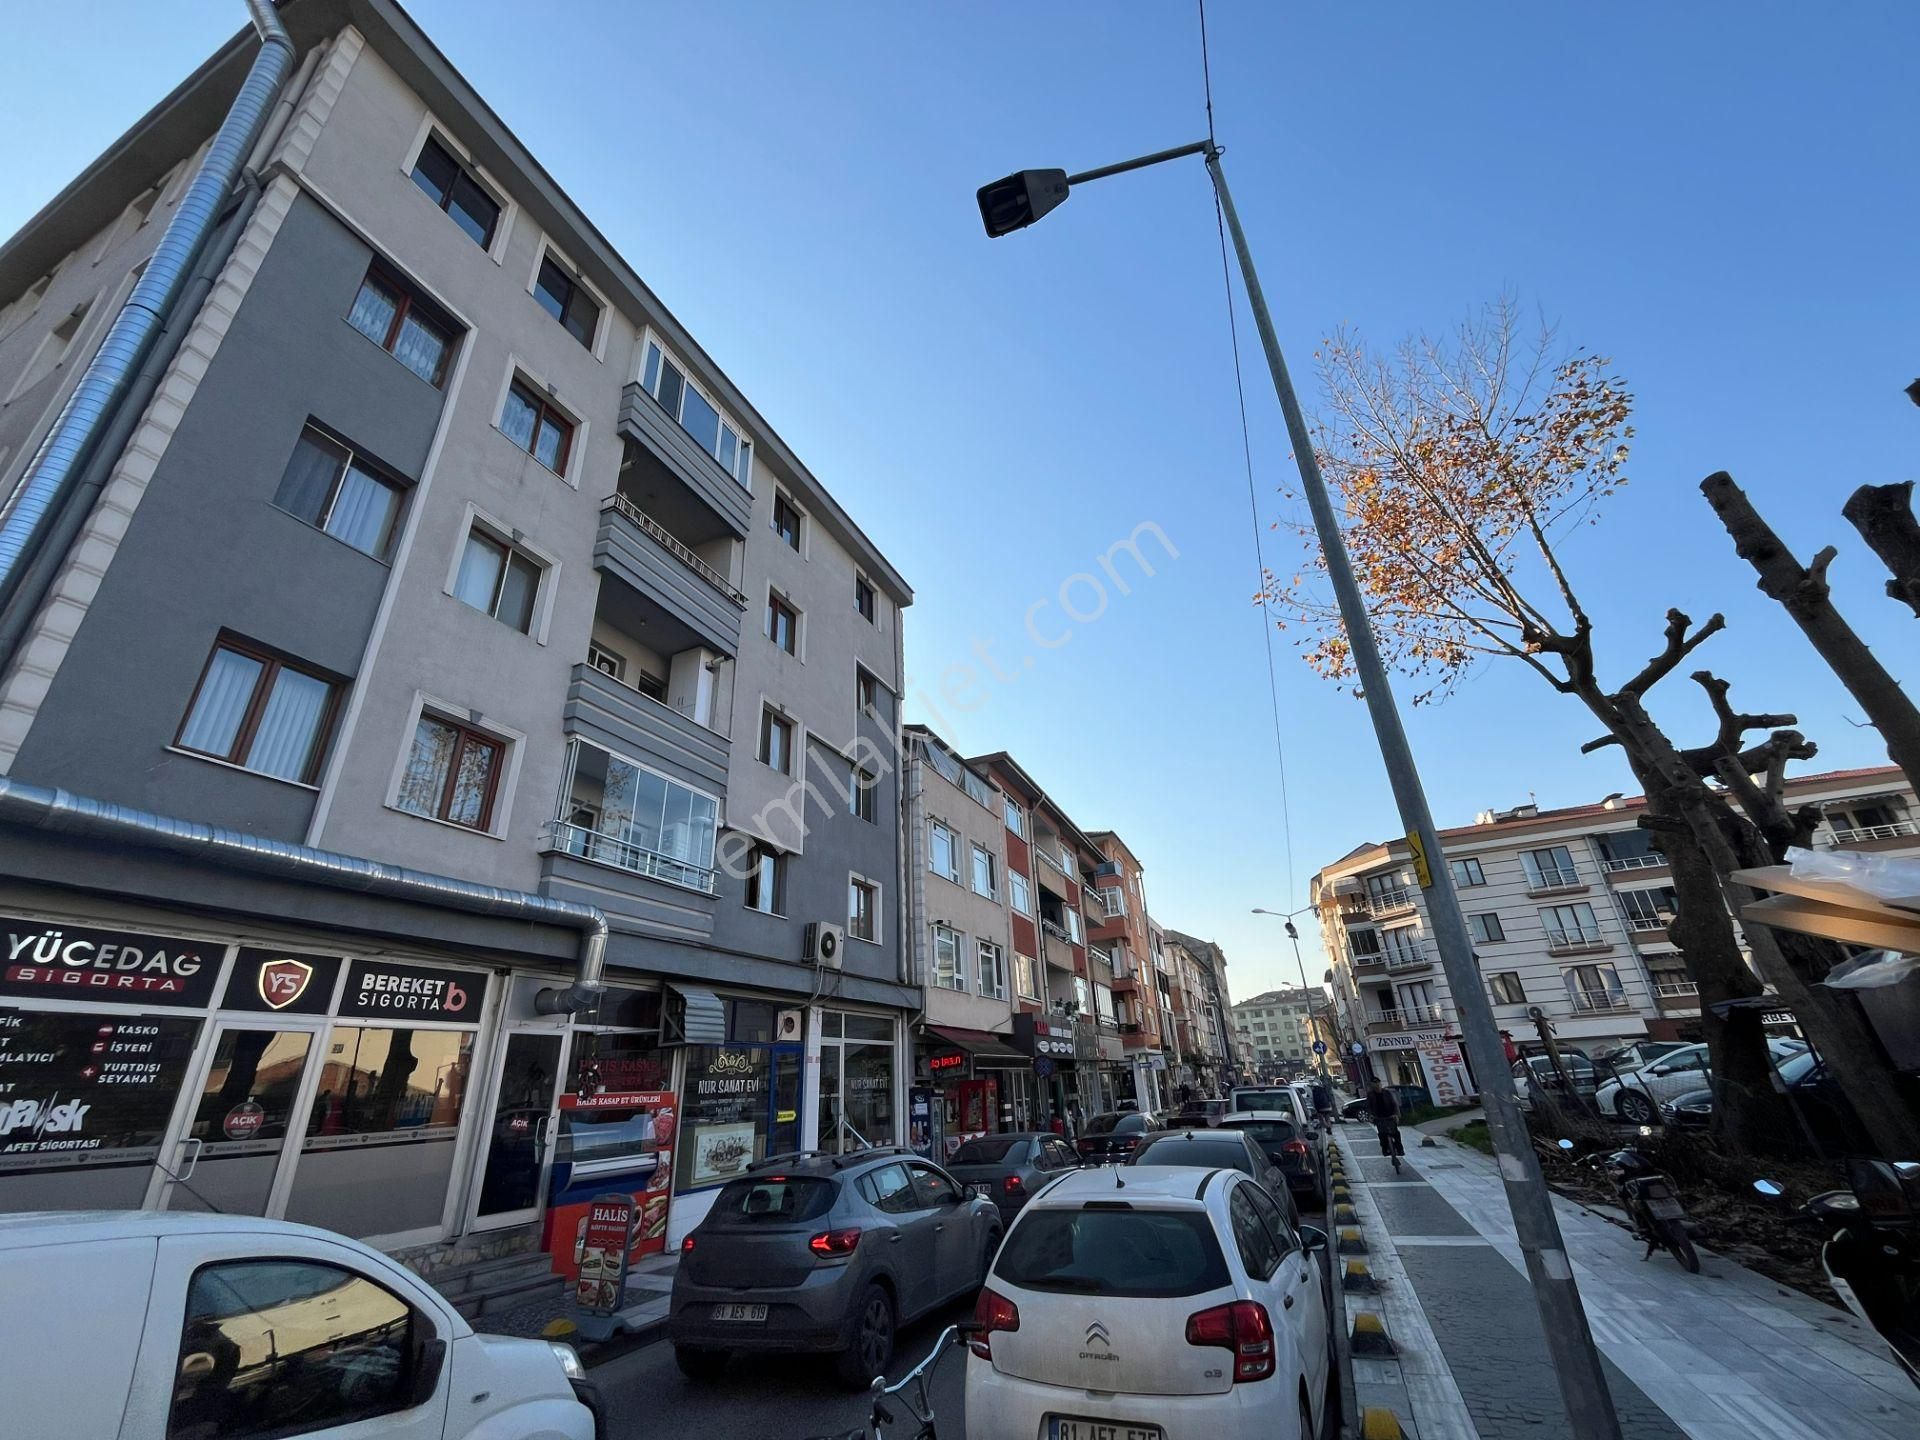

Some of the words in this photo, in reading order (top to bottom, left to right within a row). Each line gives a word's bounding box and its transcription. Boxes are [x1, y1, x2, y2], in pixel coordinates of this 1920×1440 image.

[361, 973, 446, 996] BEREKET
[357, 992, 440, 1011] SİGORTA
[116, 1025, 159, 1035] KASKO
[110, 1041, 153, 1053] İŞYERİ
[1376, 1035, 1413, 1047] ZEYNEP
[97, 1074, 157, 1084] SEYAHAT
[698, 1079, 717, 1095] NUR
[717, 1079, 746, 1094] SANAT
[746, 1077, 760, 1093] EVİ
[230, 1115, 258, 1126] AÇIK
[2, 1141, 39, 1153] AFET
[592, 1206, 629, 1222] HALİS
